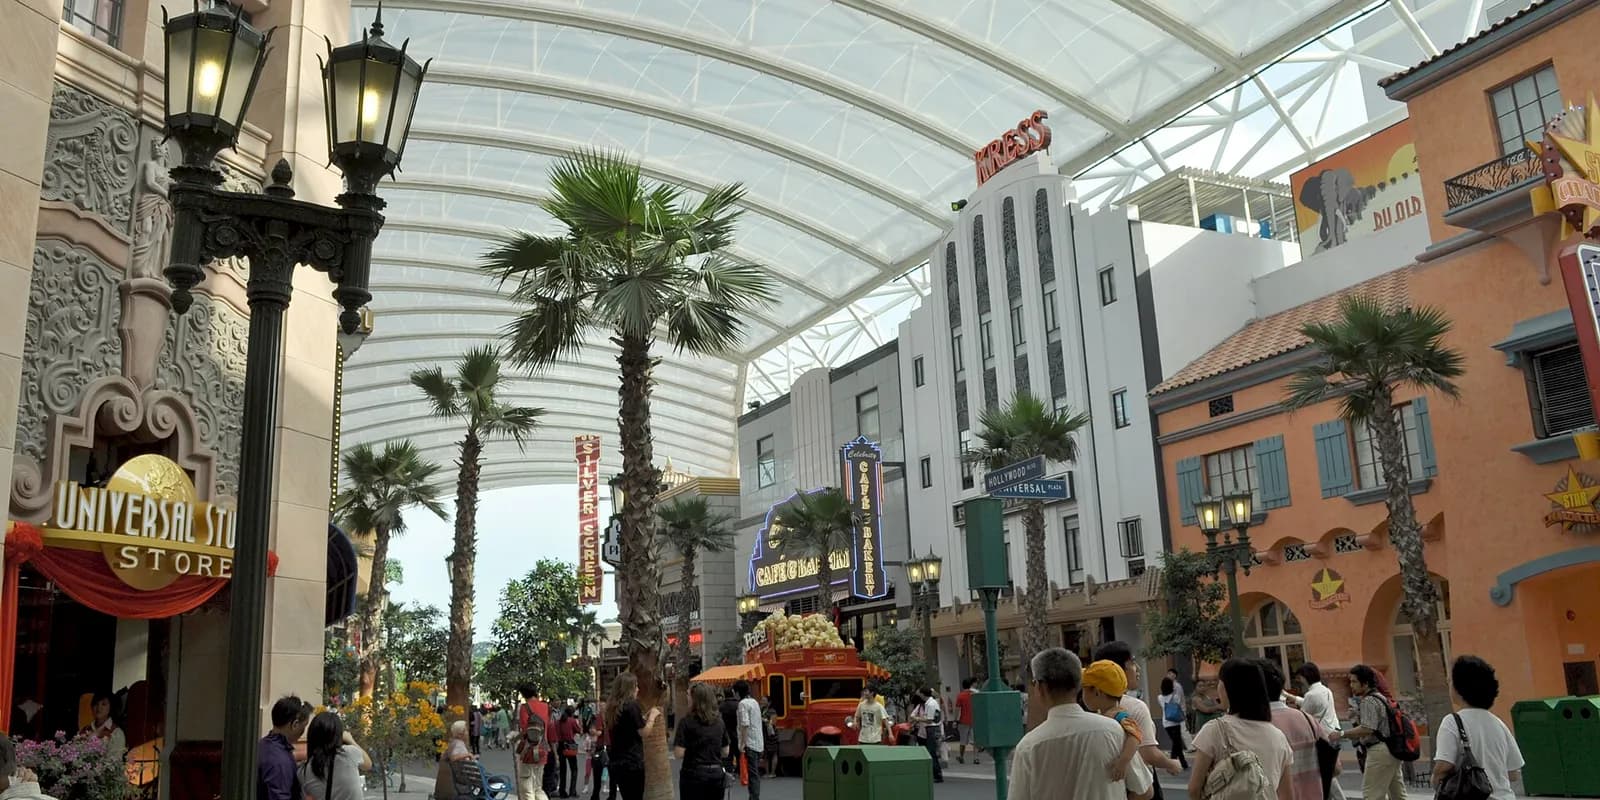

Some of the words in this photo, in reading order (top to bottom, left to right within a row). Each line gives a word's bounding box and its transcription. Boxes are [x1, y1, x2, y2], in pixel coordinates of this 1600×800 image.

[975, 109, 1051, 188] KRESS
[582, 443, 594, 515] SILVER
[987, 466, 1026, 488] HOLLYWOOD
[999, 482, 1047, 494] NIVERSAL
[1562, 491, 1589, 509] STAR
[55, 481, 196, 544] UNIVERSAL
[119, 545, 233, 579] STORE
[583, 525, 596, 598] SCREEN
[862, 526, 876, 597] BAKERY
